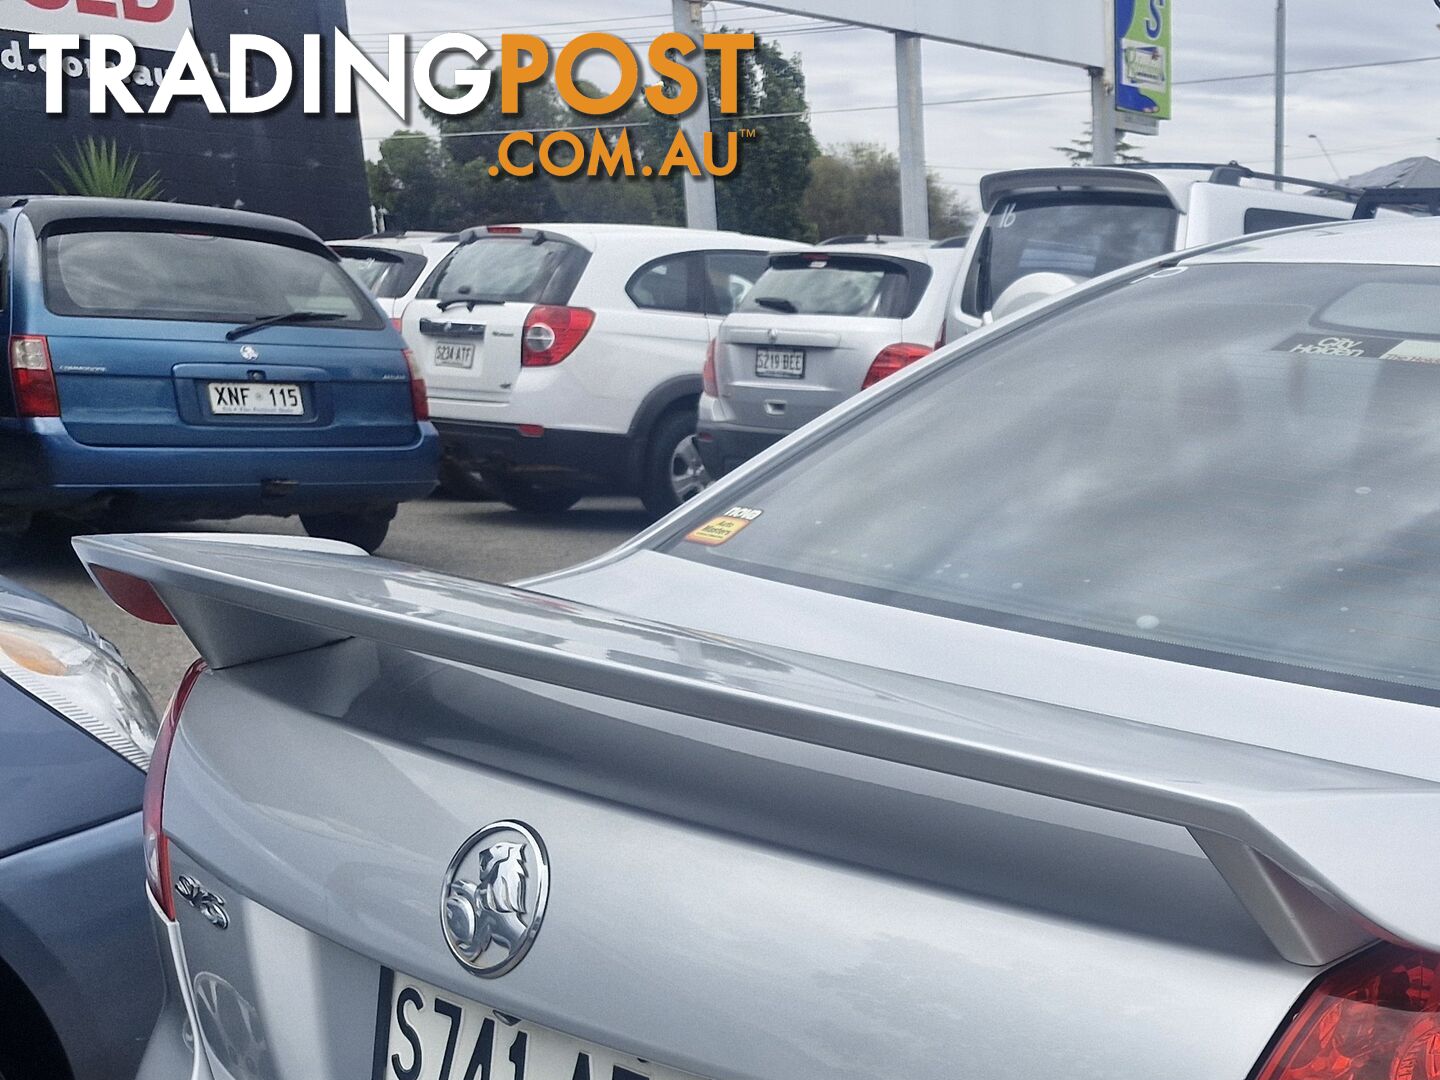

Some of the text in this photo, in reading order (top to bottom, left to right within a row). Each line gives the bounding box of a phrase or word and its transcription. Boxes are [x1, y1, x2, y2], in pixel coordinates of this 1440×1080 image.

[1290, 343, 1364, 357] Holden
[214, 386, 298, 407] XNF 115
